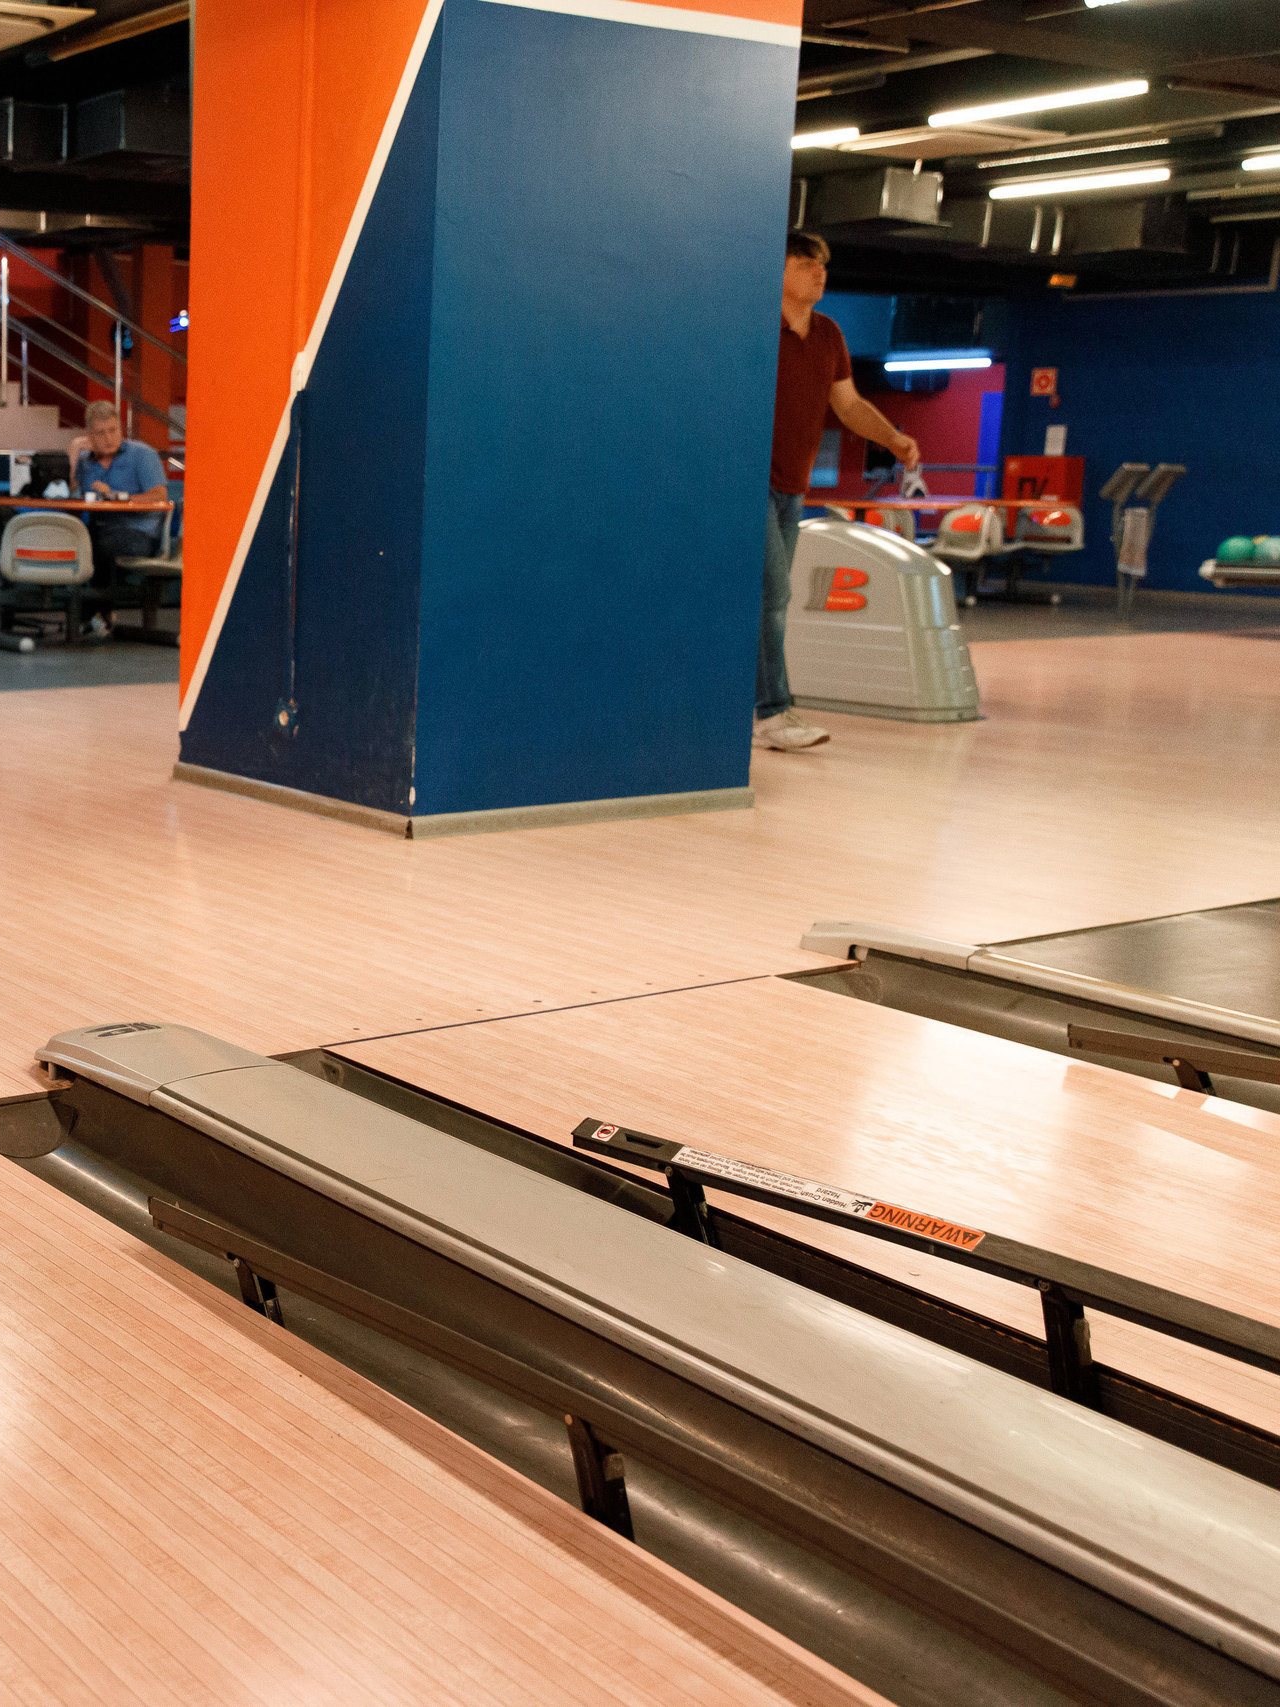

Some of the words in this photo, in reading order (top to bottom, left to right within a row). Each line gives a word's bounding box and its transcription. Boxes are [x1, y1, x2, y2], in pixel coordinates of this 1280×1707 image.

[800, 1190, 821, 1201] Crush
[816, 1188, 840, 1199] Hazard
[821, 1197, 847, 1208] Hidden
[869, 1205, 961, 1242] WARNING
